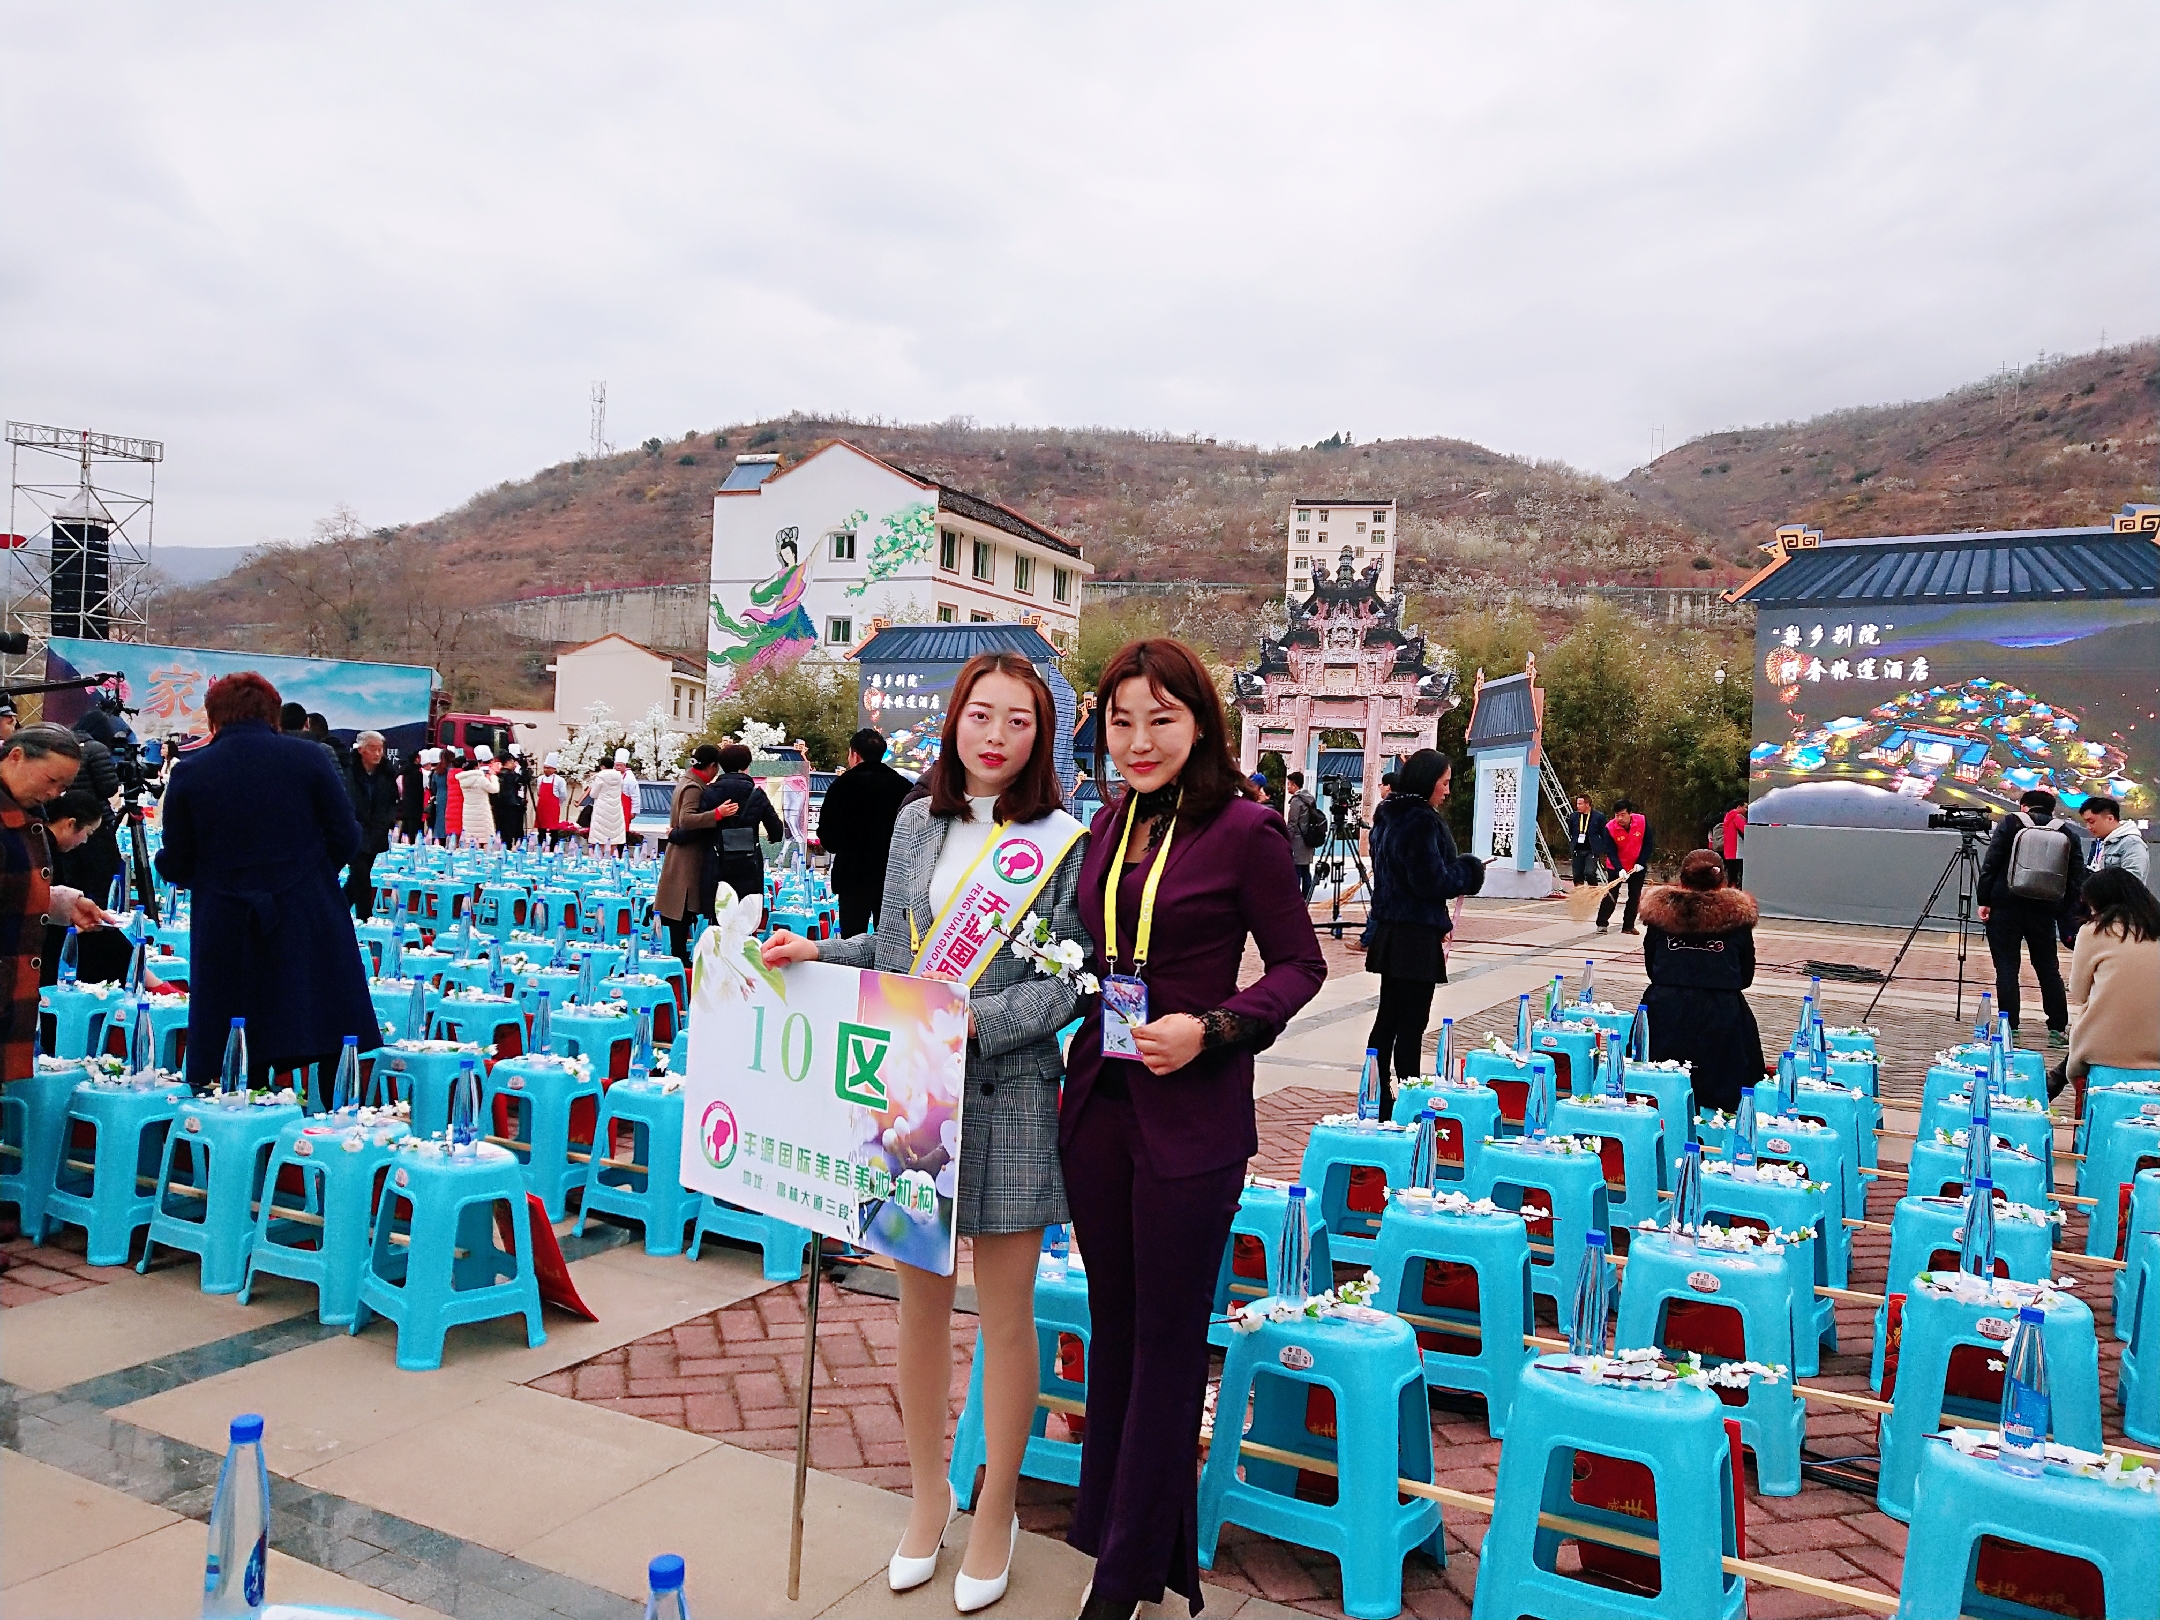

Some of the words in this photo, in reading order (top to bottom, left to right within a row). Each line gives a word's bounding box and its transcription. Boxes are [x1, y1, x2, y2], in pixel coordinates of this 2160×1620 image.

[965, 882, 984, 911] FENG
[942, 911, 966, 941] YUAN
[931, 938, 949, 961] GUO
[747, 1005, 813, 1083] 10
[834, 1021, 892, 1112] 区
